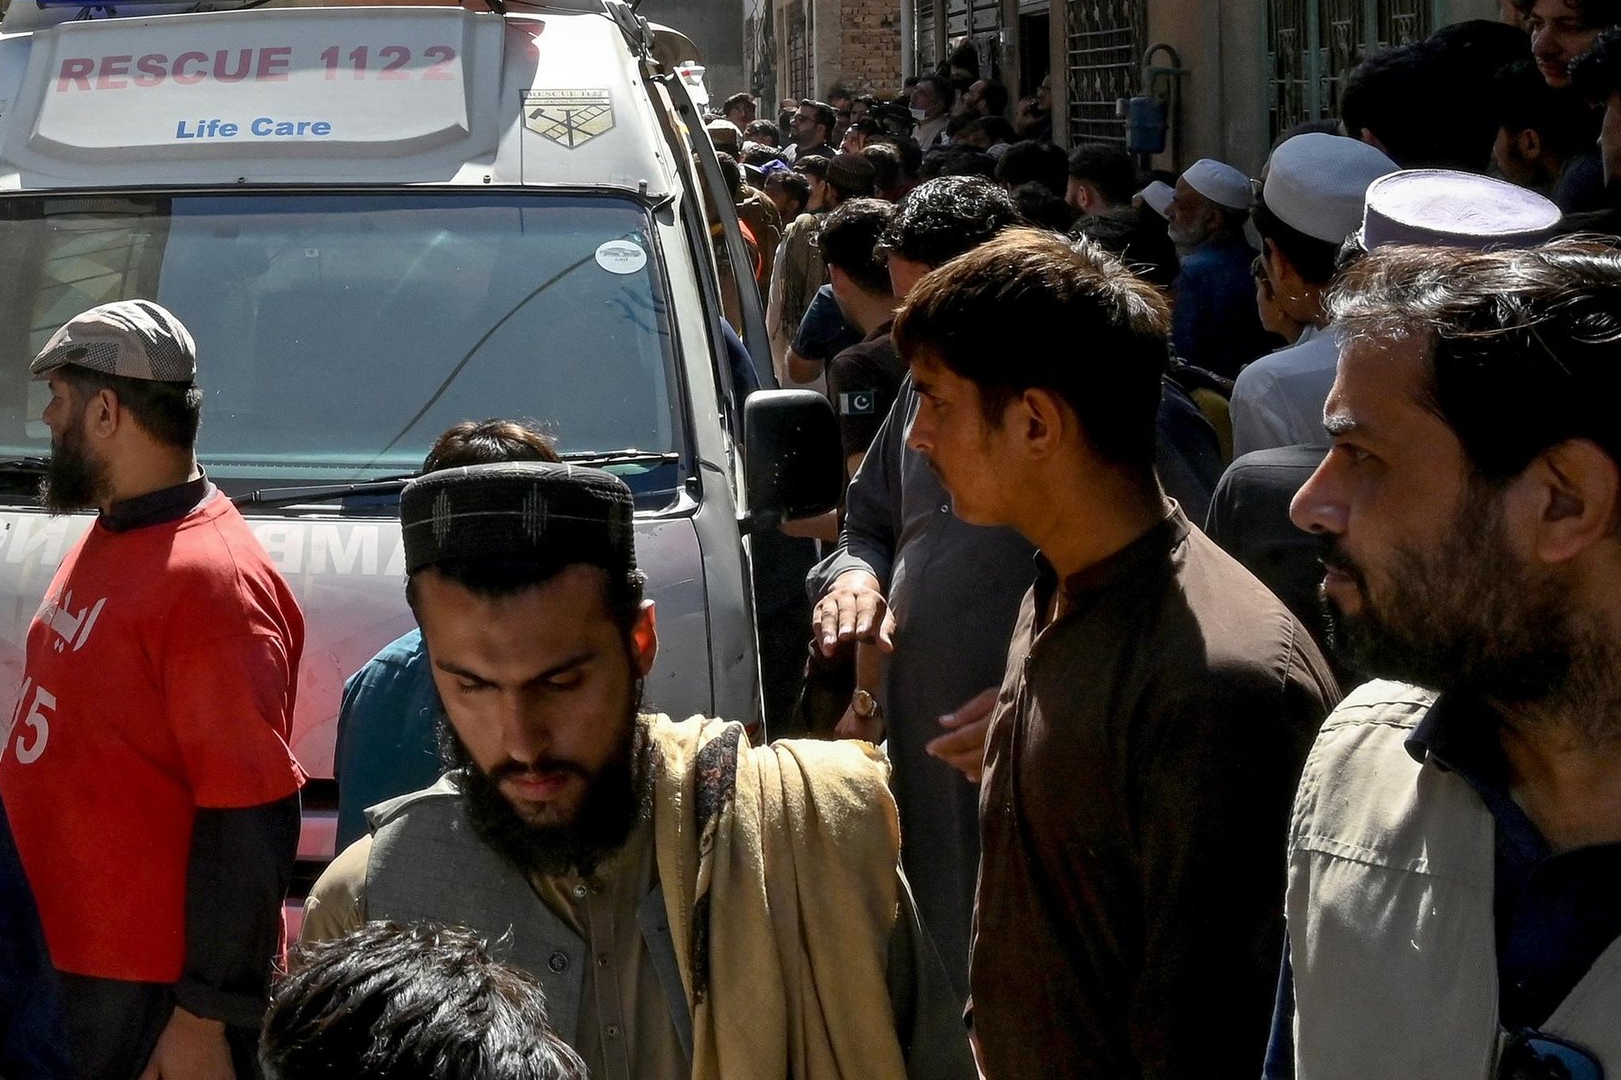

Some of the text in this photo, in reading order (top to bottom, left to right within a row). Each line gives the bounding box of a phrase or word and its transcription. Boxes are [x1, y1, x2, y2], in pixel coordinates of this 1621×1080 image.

[55, 44, 458, 92] RESCUE 1122
[175, 117, 332, 141] Life Care
